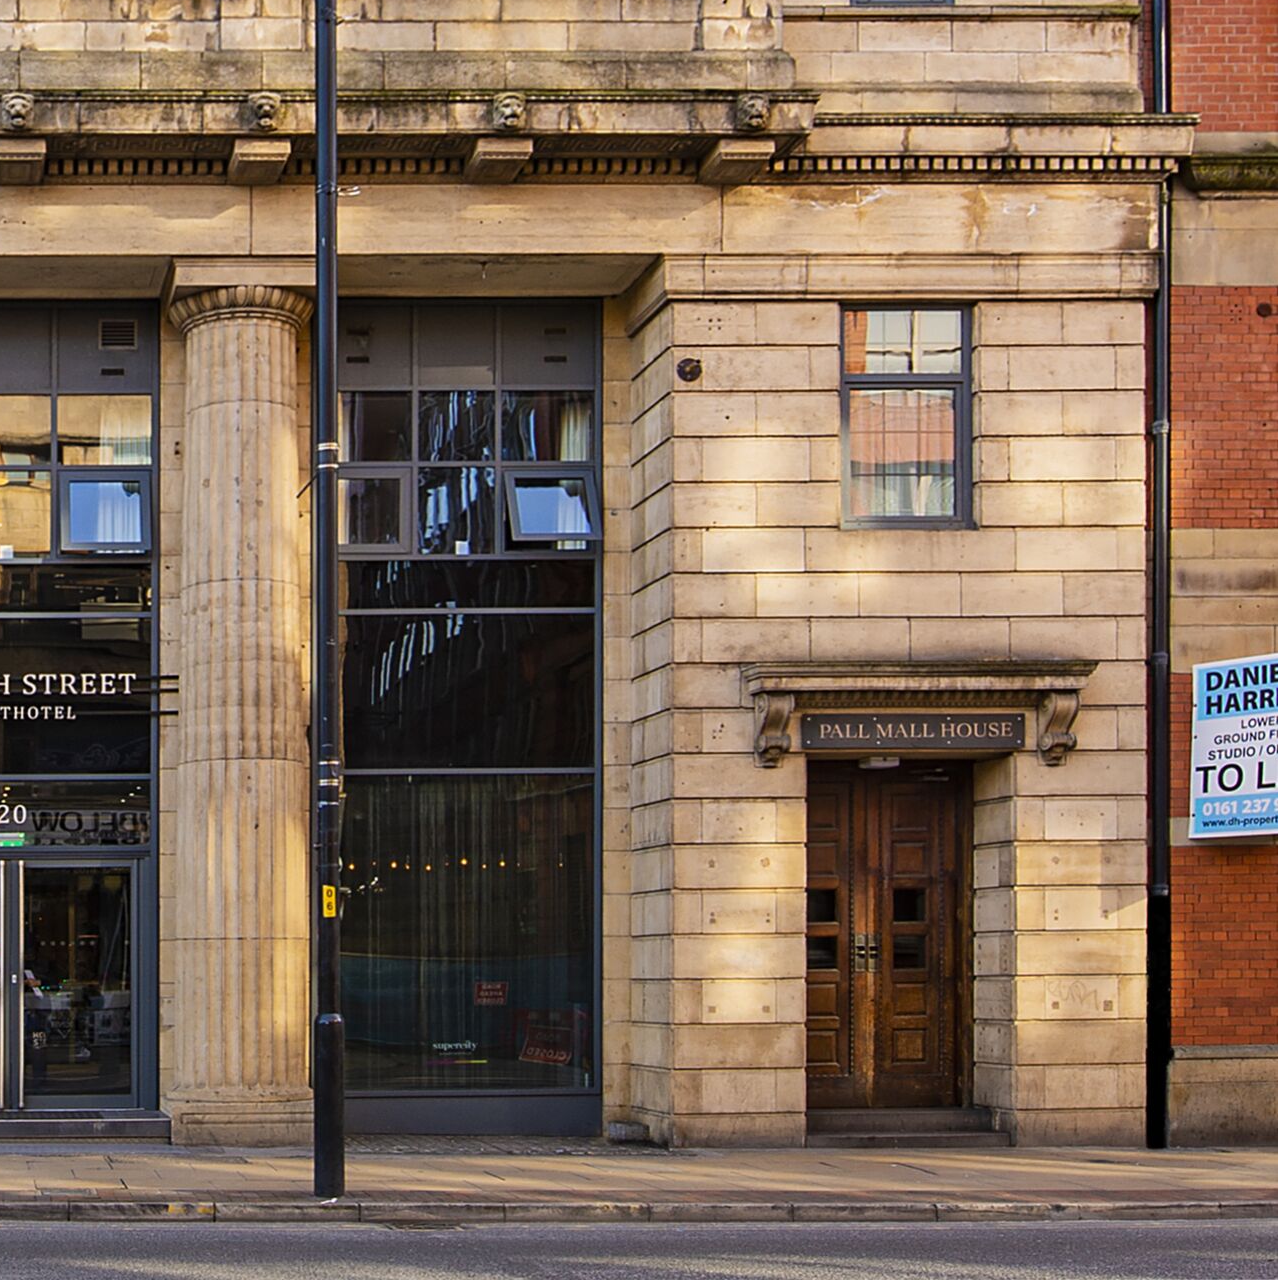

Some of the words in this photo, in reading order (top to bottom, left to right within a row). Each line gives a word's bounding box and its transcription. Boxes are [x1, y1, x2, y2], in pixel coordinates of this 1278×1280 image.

[22, 673, 137, 695] STREET
[820, 724, 870, 739] PALL
[876, 723, 935, 738] MALL
[941, 722, 1014, 738] HOUSE
[1241, 716, 1278, 729] LOWE
[1214, 731, 1266, 745] GROUND
[1208, 746, 1256, 760] STUDIO
[1259, 745, 1263, 756] /
[1195, 763, 1244, 794] TO
[1203, 801, 1237, 816] 0161
[1242, 799, 1271, 814] 237
